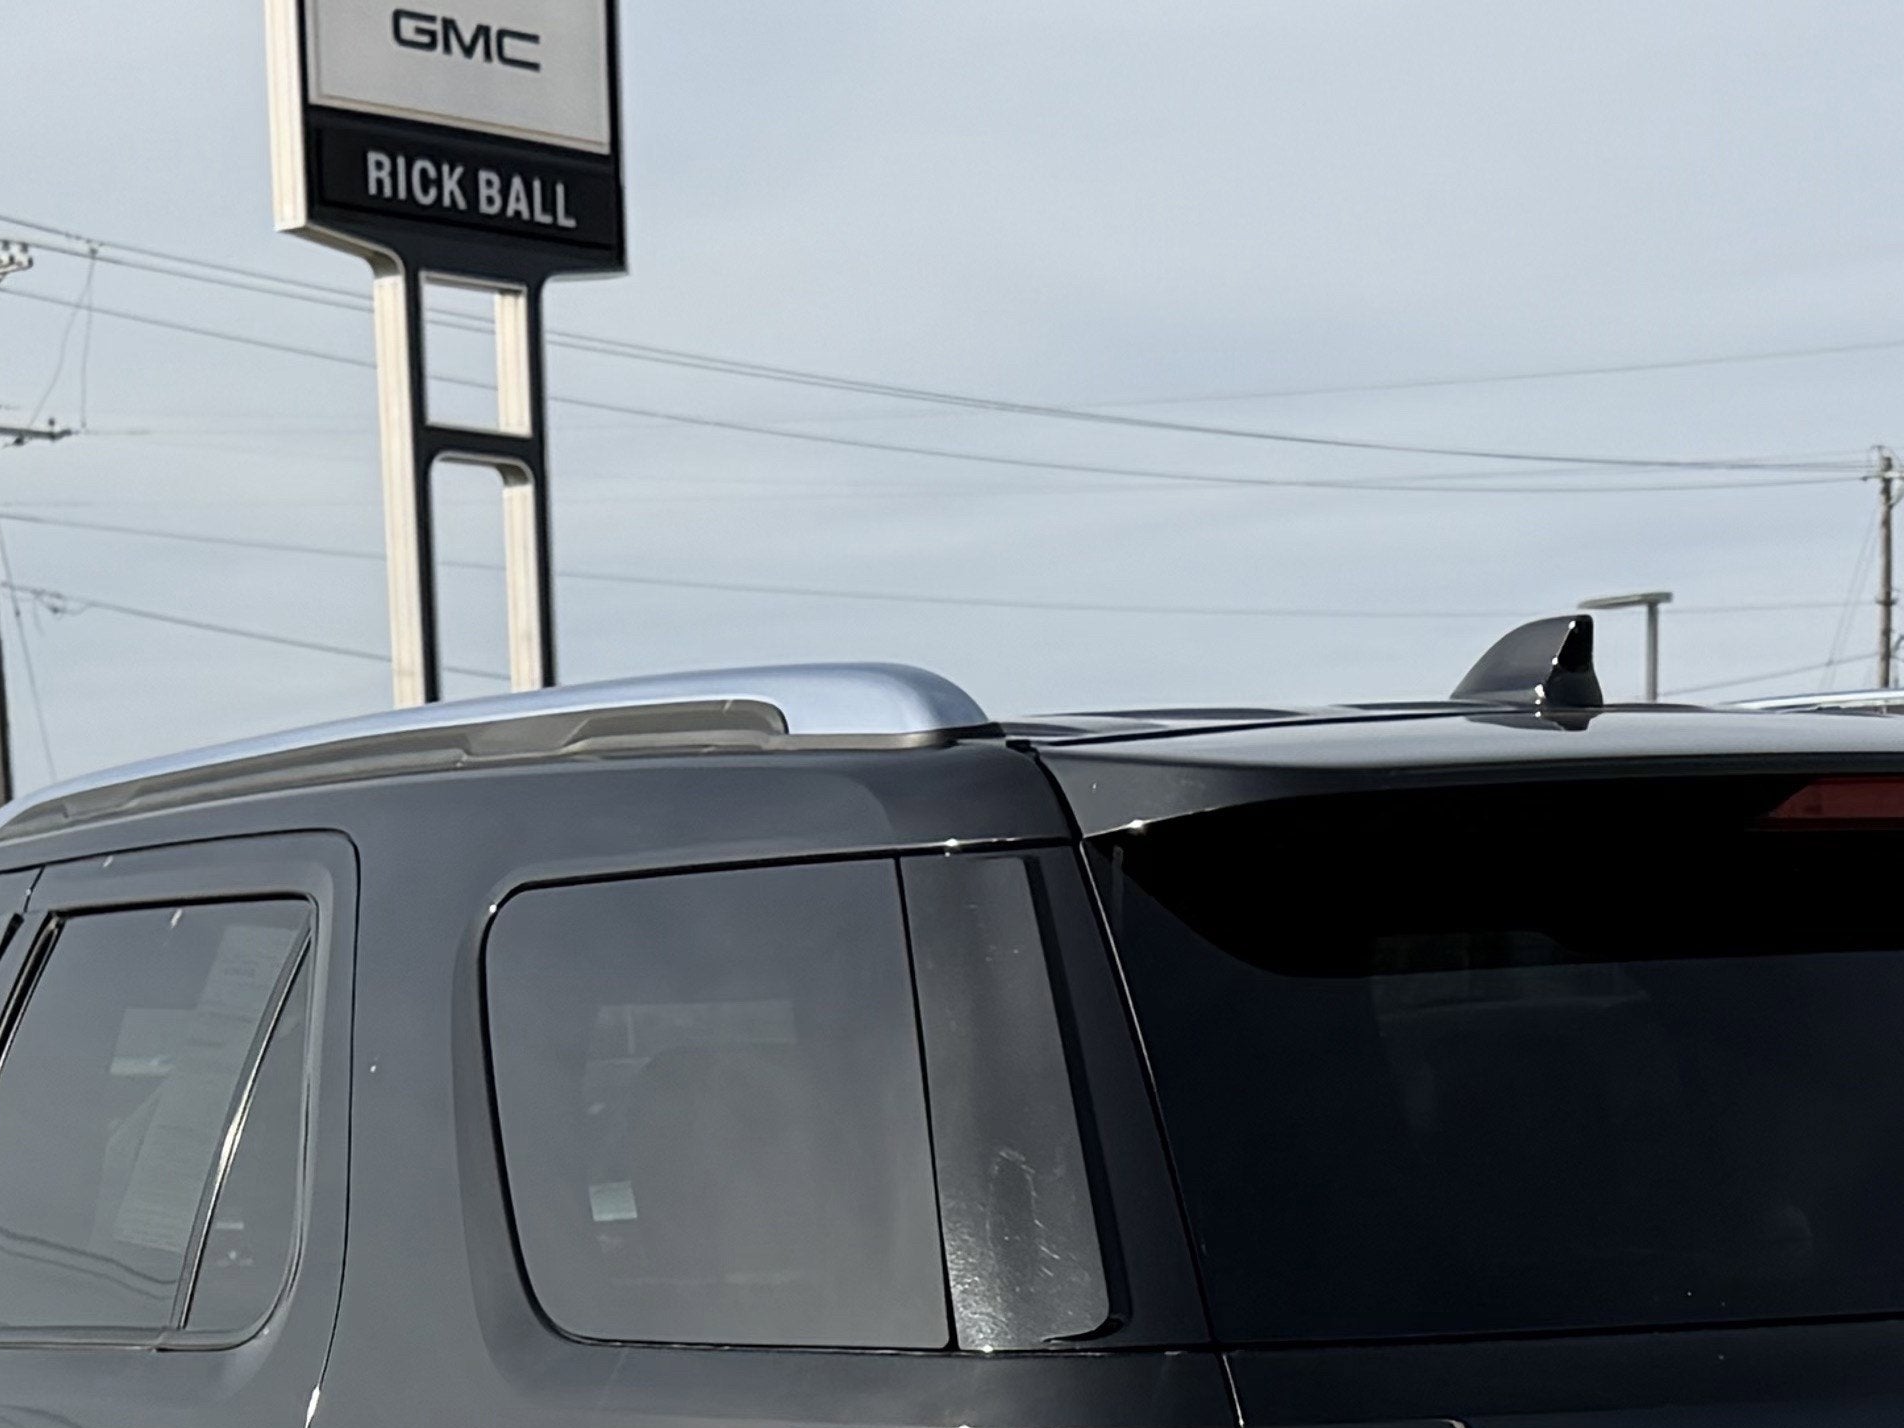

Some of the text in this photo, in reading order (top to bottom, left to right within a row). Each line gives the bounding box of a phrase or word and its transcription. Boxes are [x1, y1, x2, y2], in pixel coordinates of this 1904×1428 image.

[392, 8, 541, 72] GMC
[366, 151, 577, 229] RICK BALL
